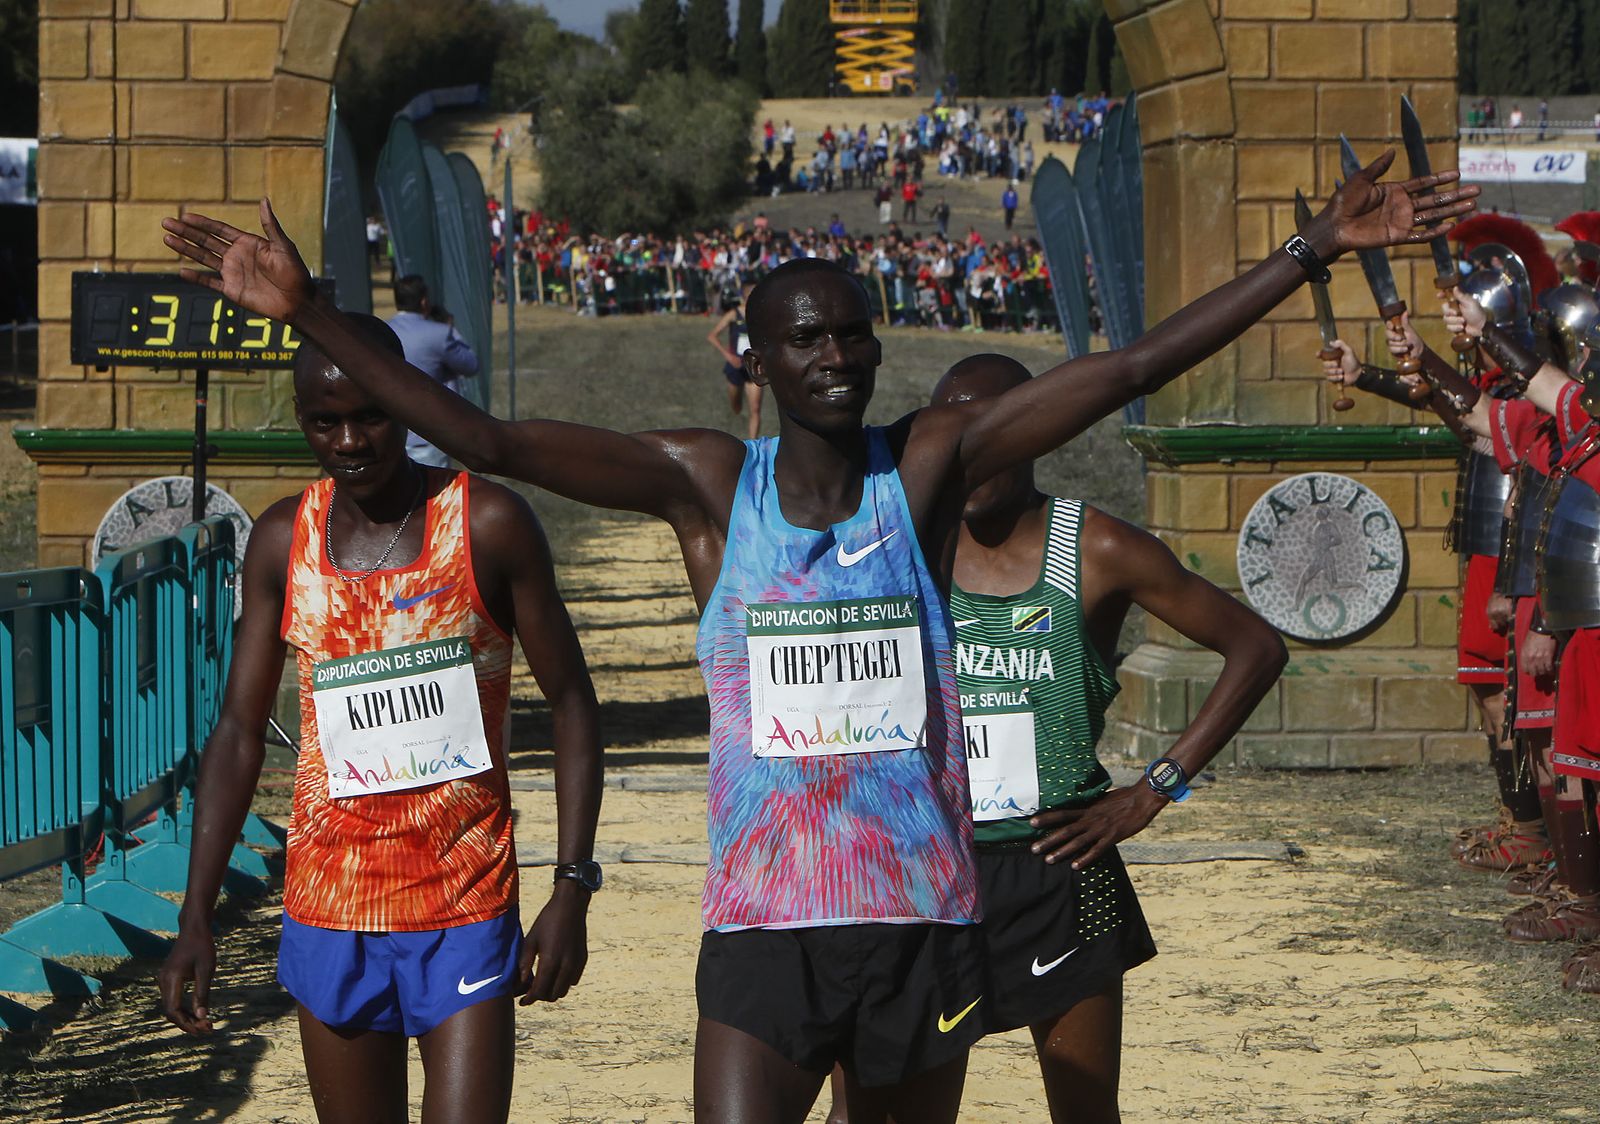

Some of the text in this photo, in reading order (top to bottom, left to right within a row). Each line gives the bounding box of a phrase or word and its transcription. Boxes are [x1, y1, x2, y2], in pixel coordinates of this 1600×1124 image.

[752, 601, 913, 628] DIPUTACION DE SEVILLA
[317, 642, 466, 683] DIPUTACION DE SEVILLA
[769, 638, 903, 685] CHEPTEGEI
[345, 680, 445, 731] KIPLIMO
[960, 690, 1029, 708] DE SEVILLA
[766, 709, 914, 751] Andalucía
[343, 742, 477, 789] Andalucía
